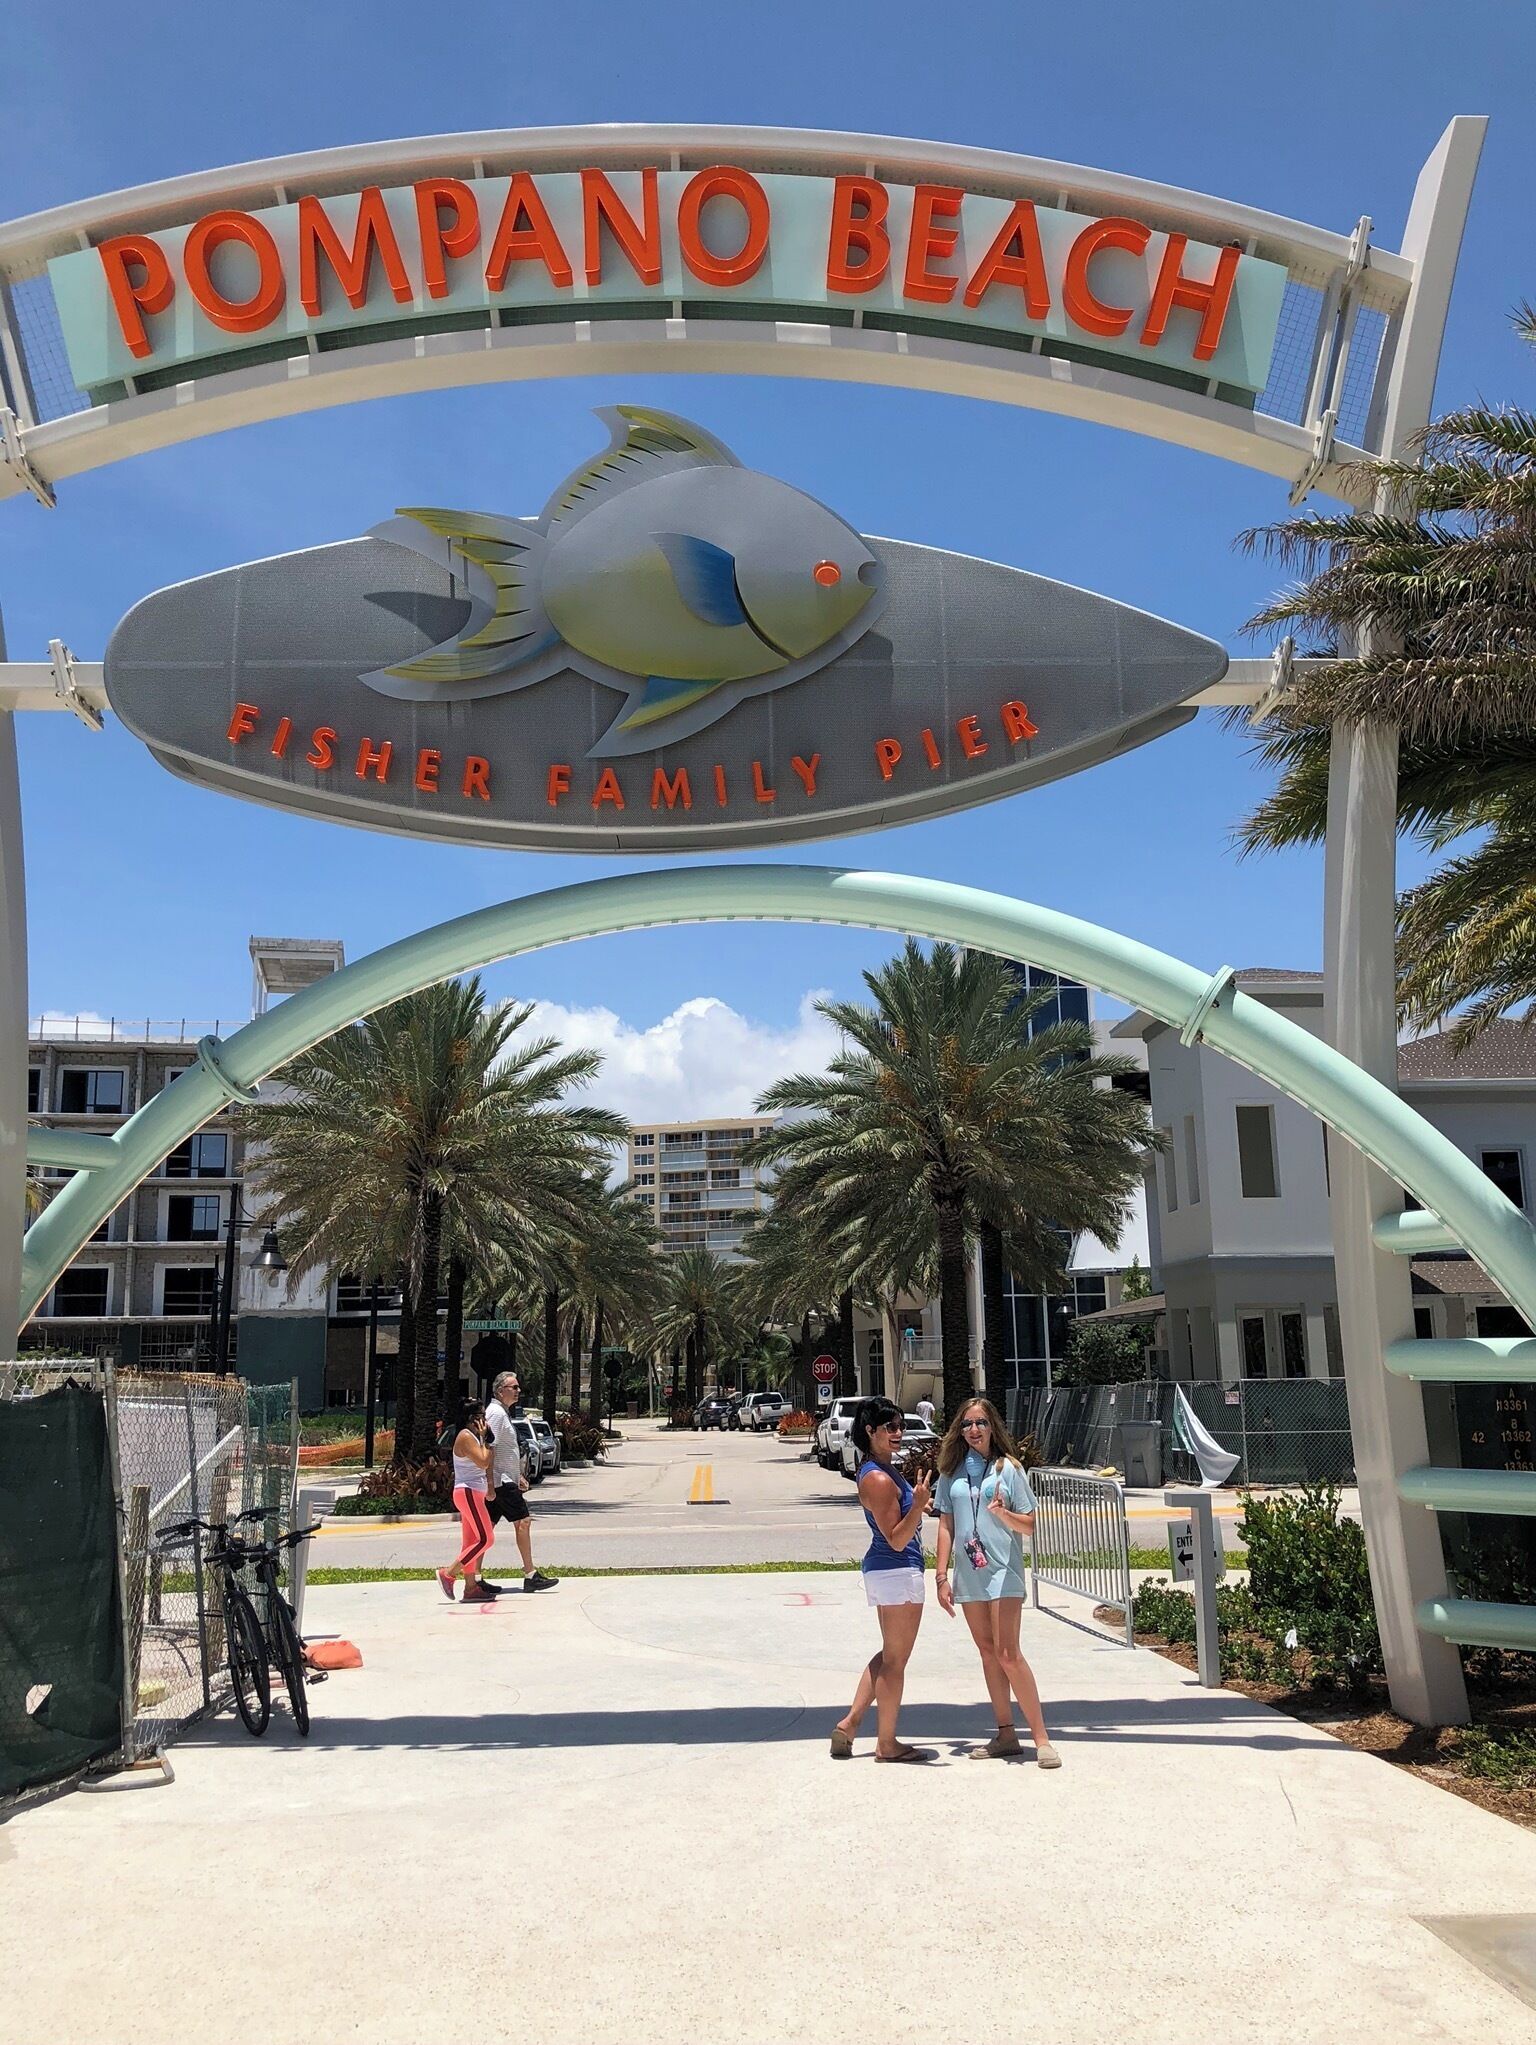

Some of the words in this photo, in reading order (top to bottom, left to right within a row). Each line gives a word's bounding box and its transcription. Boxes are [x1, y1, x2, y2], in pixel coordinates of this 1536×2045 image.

[98, 165, 770, 359] POMPANO
[826, 175, 1243, 360] BEACH
[225, 702, 492, 801] FISHER
[546, 752, 822, 810] FAMILY
[875, 700, 1039, 782] PIER
[464, 1320, 487, 1329] POMPANO
[490, 1320, 505, 1329] BEACH
[508, 1320, 522, 1329] BLVD
[814, 1363, 836, 1374] STOP
[1509, 1387, 1515, 1399] A
[1511, 1418, 1518, 1430] B
[1471, 1431, 1486, 1444] 42
[1501, 1430, 1532, 1443] 13362
[1514, 1449, 1521, 1460] C
